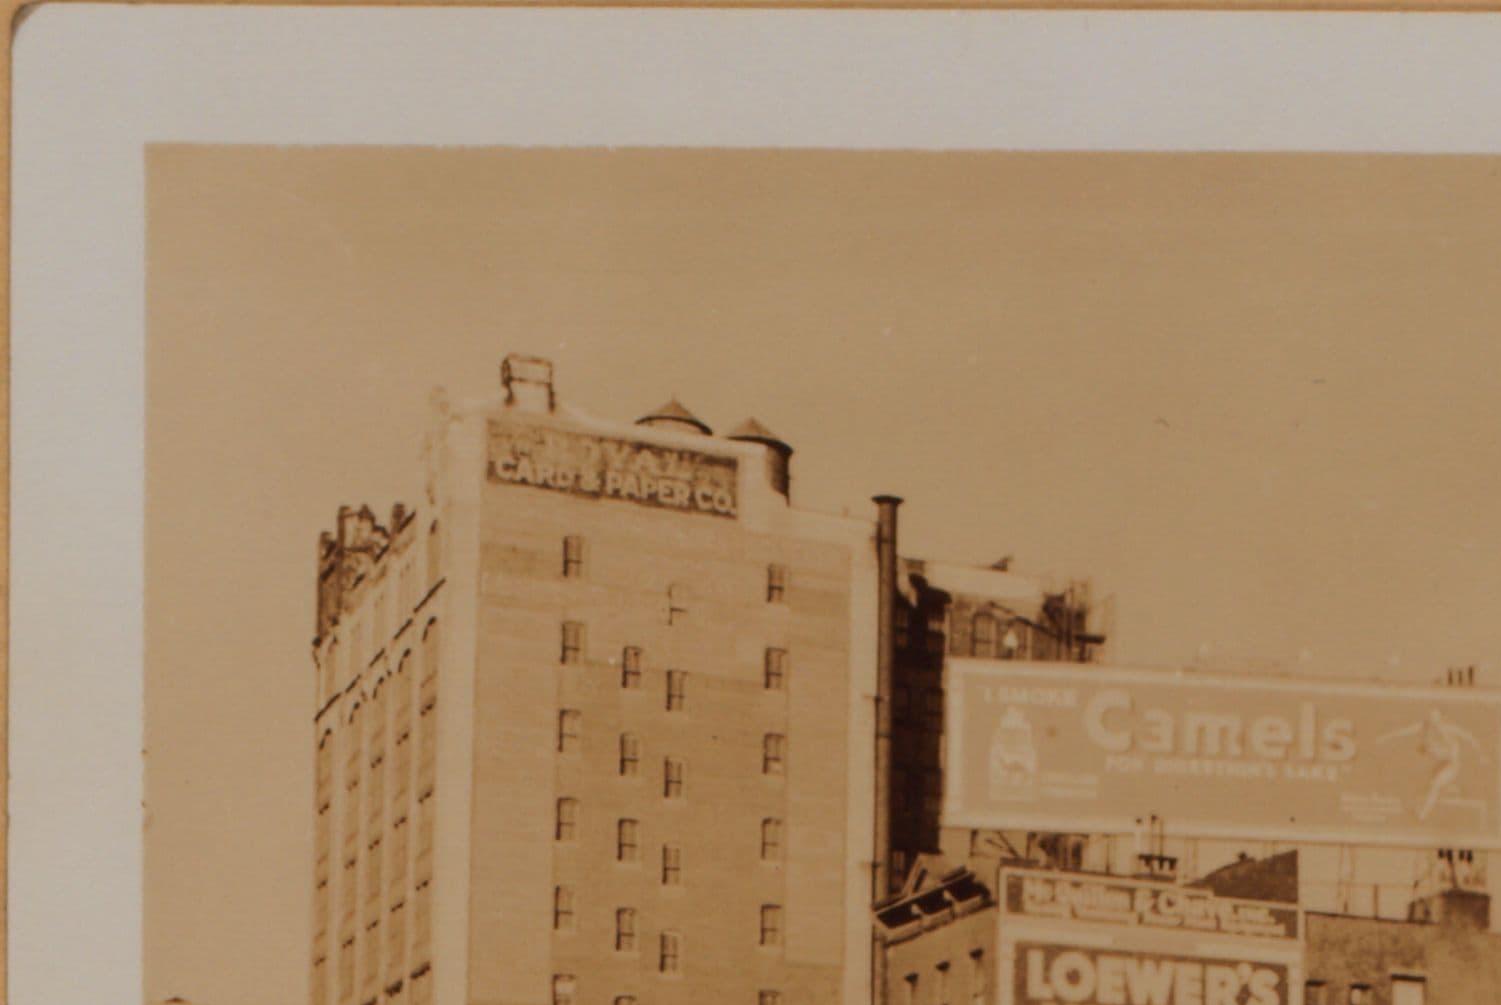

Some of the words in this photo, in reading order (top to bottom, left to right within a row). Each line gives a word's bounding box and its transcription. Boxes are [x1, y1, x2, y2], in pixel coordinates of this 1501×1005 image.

[495, 455, 574, 488] CARD
[605, 470, 691, 507] PAPER
[694, 486, 738, 515] CO.
[1084, 689, 1358, 762] Camels
